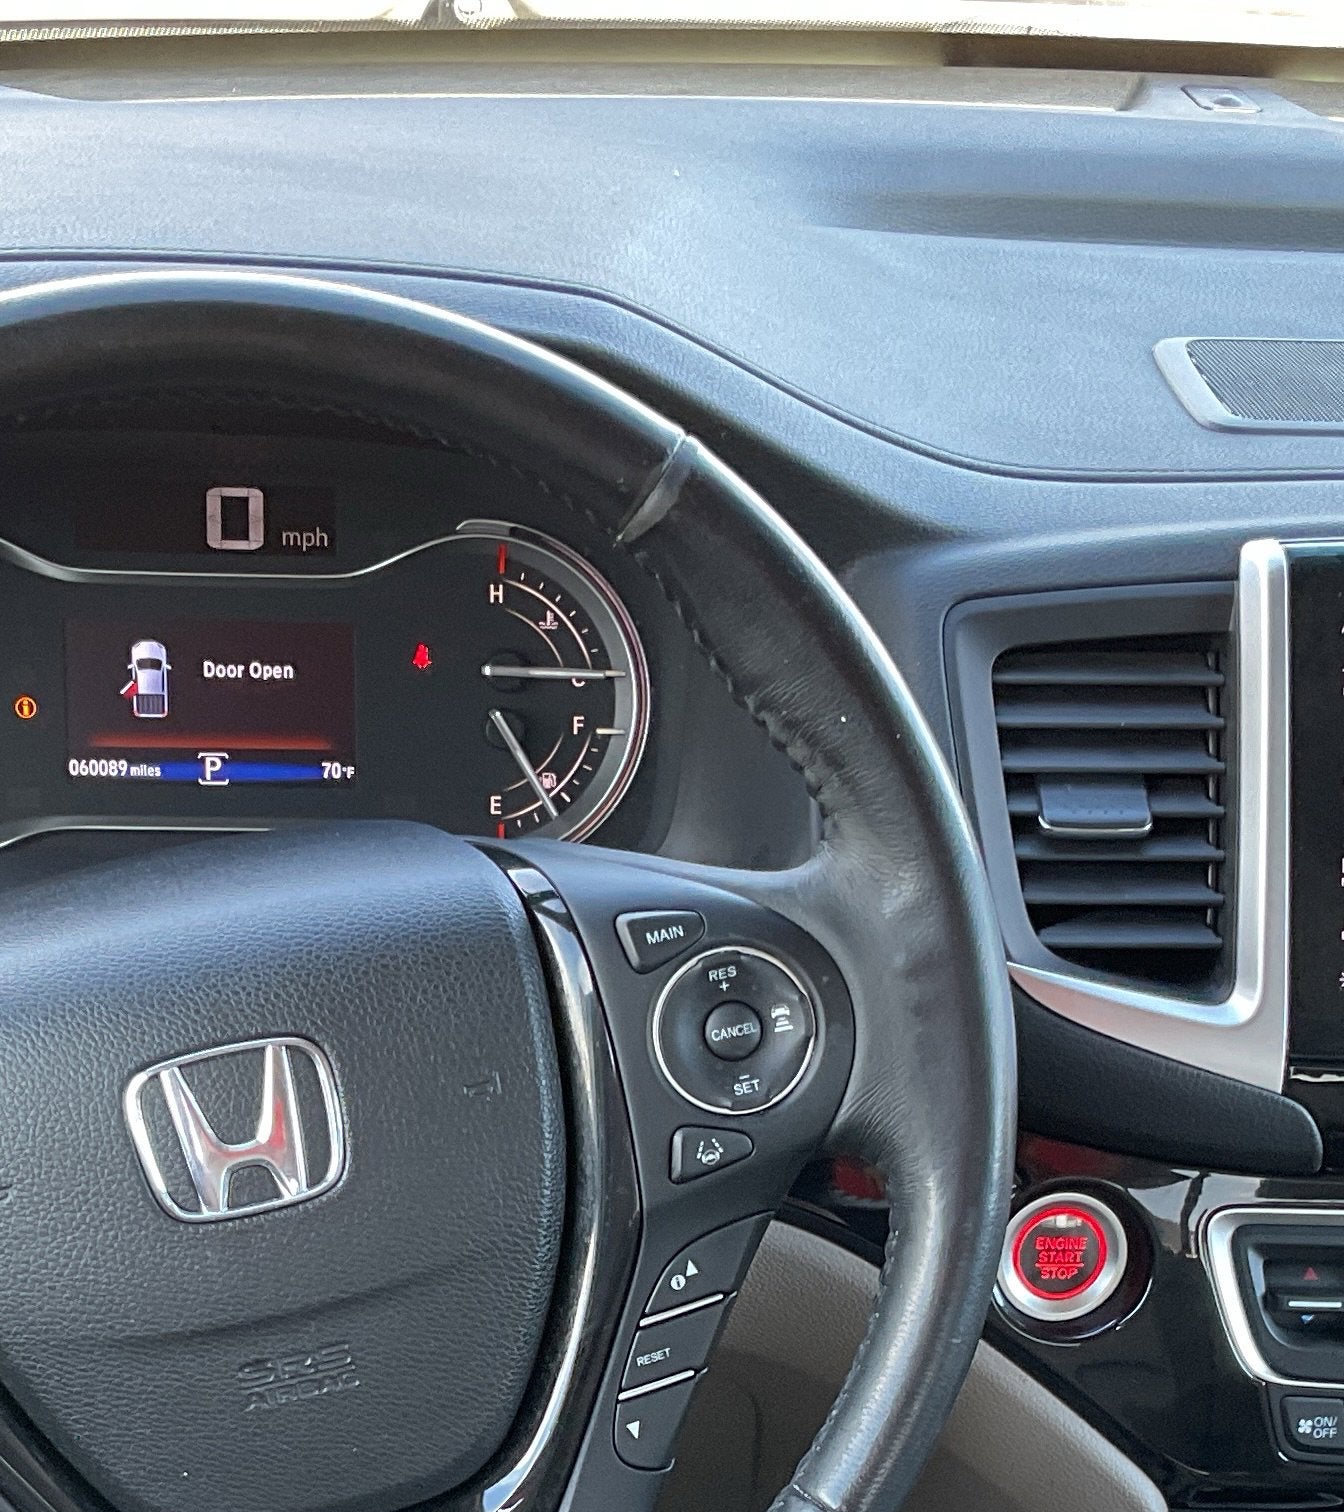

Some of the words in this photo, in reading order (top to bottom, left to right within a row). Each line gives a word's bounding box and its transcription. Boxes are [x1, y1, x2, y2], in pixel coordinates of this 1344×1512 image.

[206, 487, 264, 550] 0
[282, 527, 328, 551] mph
[489, 584, 504, 604] H
[203, 660, 244, 680] Door
[249, 661, 294, 682] Open
[572, 716, 585, 735] F
[68, 760, 128, 777] 060089
[130, 763, 161, 778] miles
[205, 758, 222, 781] P
[490, 796, 502, 815] E
[645, 923, 685, 946] MAIN
[707, 965, 738, 984] RES
[710, 1021, 758, 1042] CANCEL
[733, 1078, 760, 1097] SET
[1035, 1236, 1088, 1250] ENGINE
[1038, 1251, 1083, 1264] START
[1040, 1266, 1079, 1280] STOP
[635, 1346, 672, 1368] RESET
[1313, 1416, 1338, 1428] ON/
[1312, 1428, 1338, 1440] OFF
